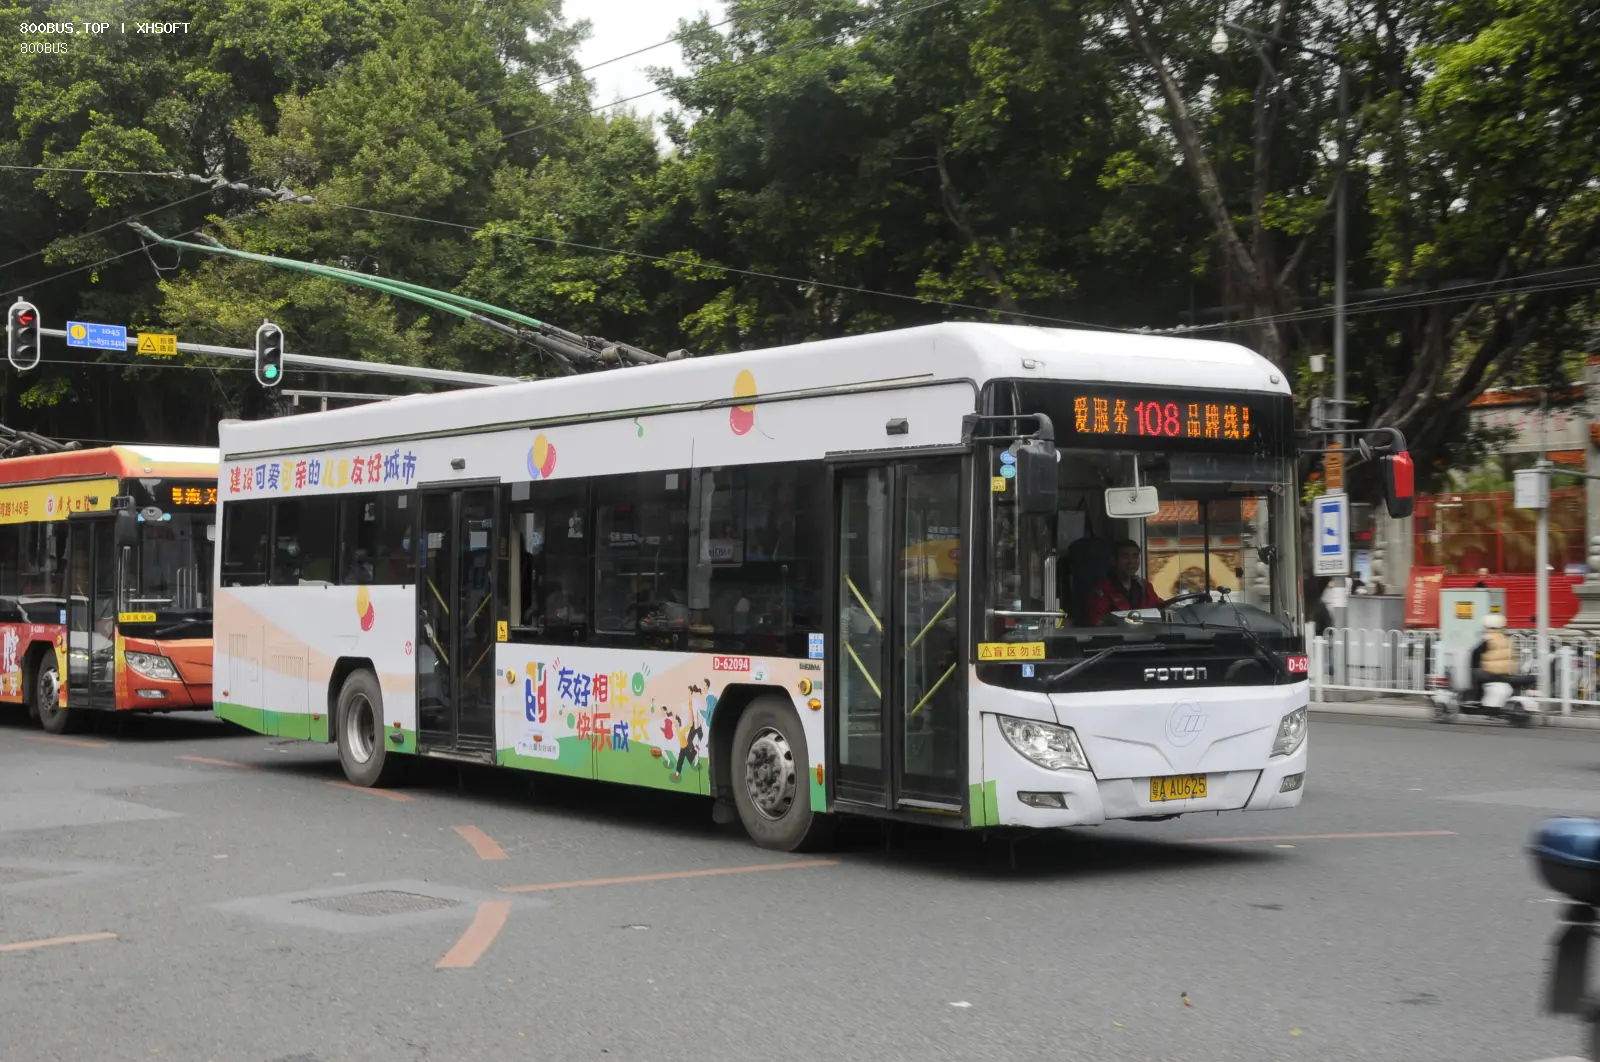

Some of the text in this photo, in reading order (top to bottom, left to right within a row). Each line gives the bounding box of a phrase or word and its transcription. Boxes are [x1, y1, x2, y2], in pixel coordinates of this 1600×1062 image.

[101, 328, 120, 337] 1045
[1133, 401, 1181, 437] 108
[229, 448, 417, 494] 建设可爱可亲的儿童友好城市
[992, 645, 1042, 658] 盲区勿近
[714, 657, 749, 671] D-62094
[1144, 667, 1208, 682] FOTON
[557, 666, 629, 709] 友好相伴
[576, 702, 650, 753] 快乐成长
[1170, 776, 1206, 797] AU625
